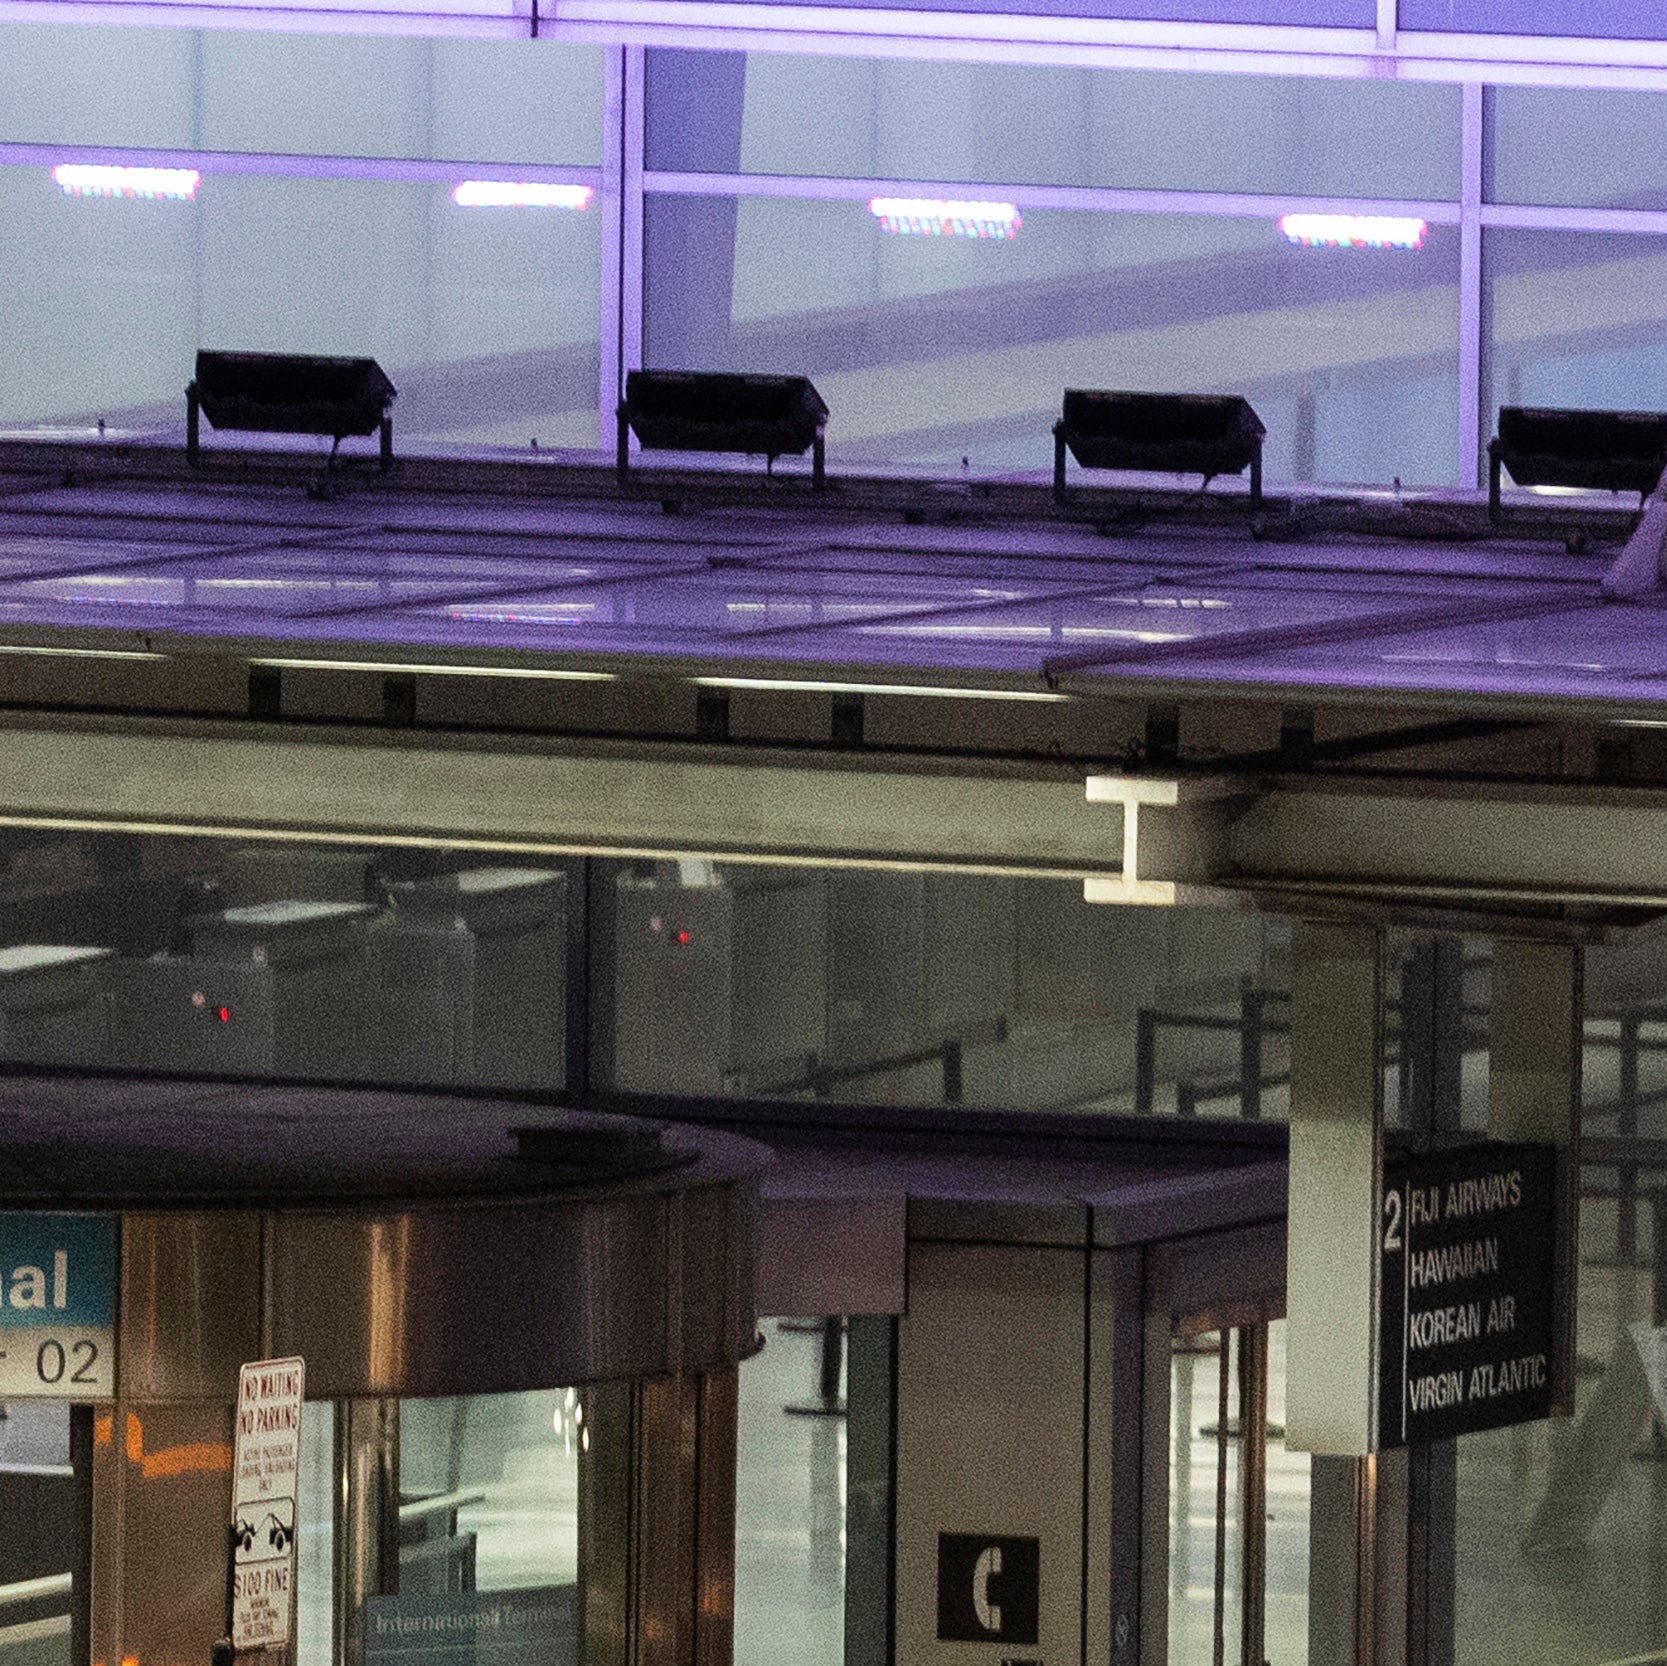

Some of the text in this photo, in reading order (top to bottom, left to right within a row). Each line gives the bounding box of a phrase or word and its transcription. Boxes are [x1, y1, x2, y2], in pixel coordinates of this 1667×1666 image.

[1384, 1170, 1521, 1250] 2 FIJI AIRWAYS
[1410, 1237, 1498, 1288] HAWAIIAN
[1410, 1295, 1515, 1350] KOREAN AIR
[37, 1338, 99, 1384] 02
[243, 1370, 299, 1401] NO WAITING
[1409, 1354, 1547, 1418] VIRGIN ATLANTIC
[240, 1404, 297, 1434] NO PARKING
[265, 1567, 287, 1593] FINE
[376, 1607, 501, 1635] International
